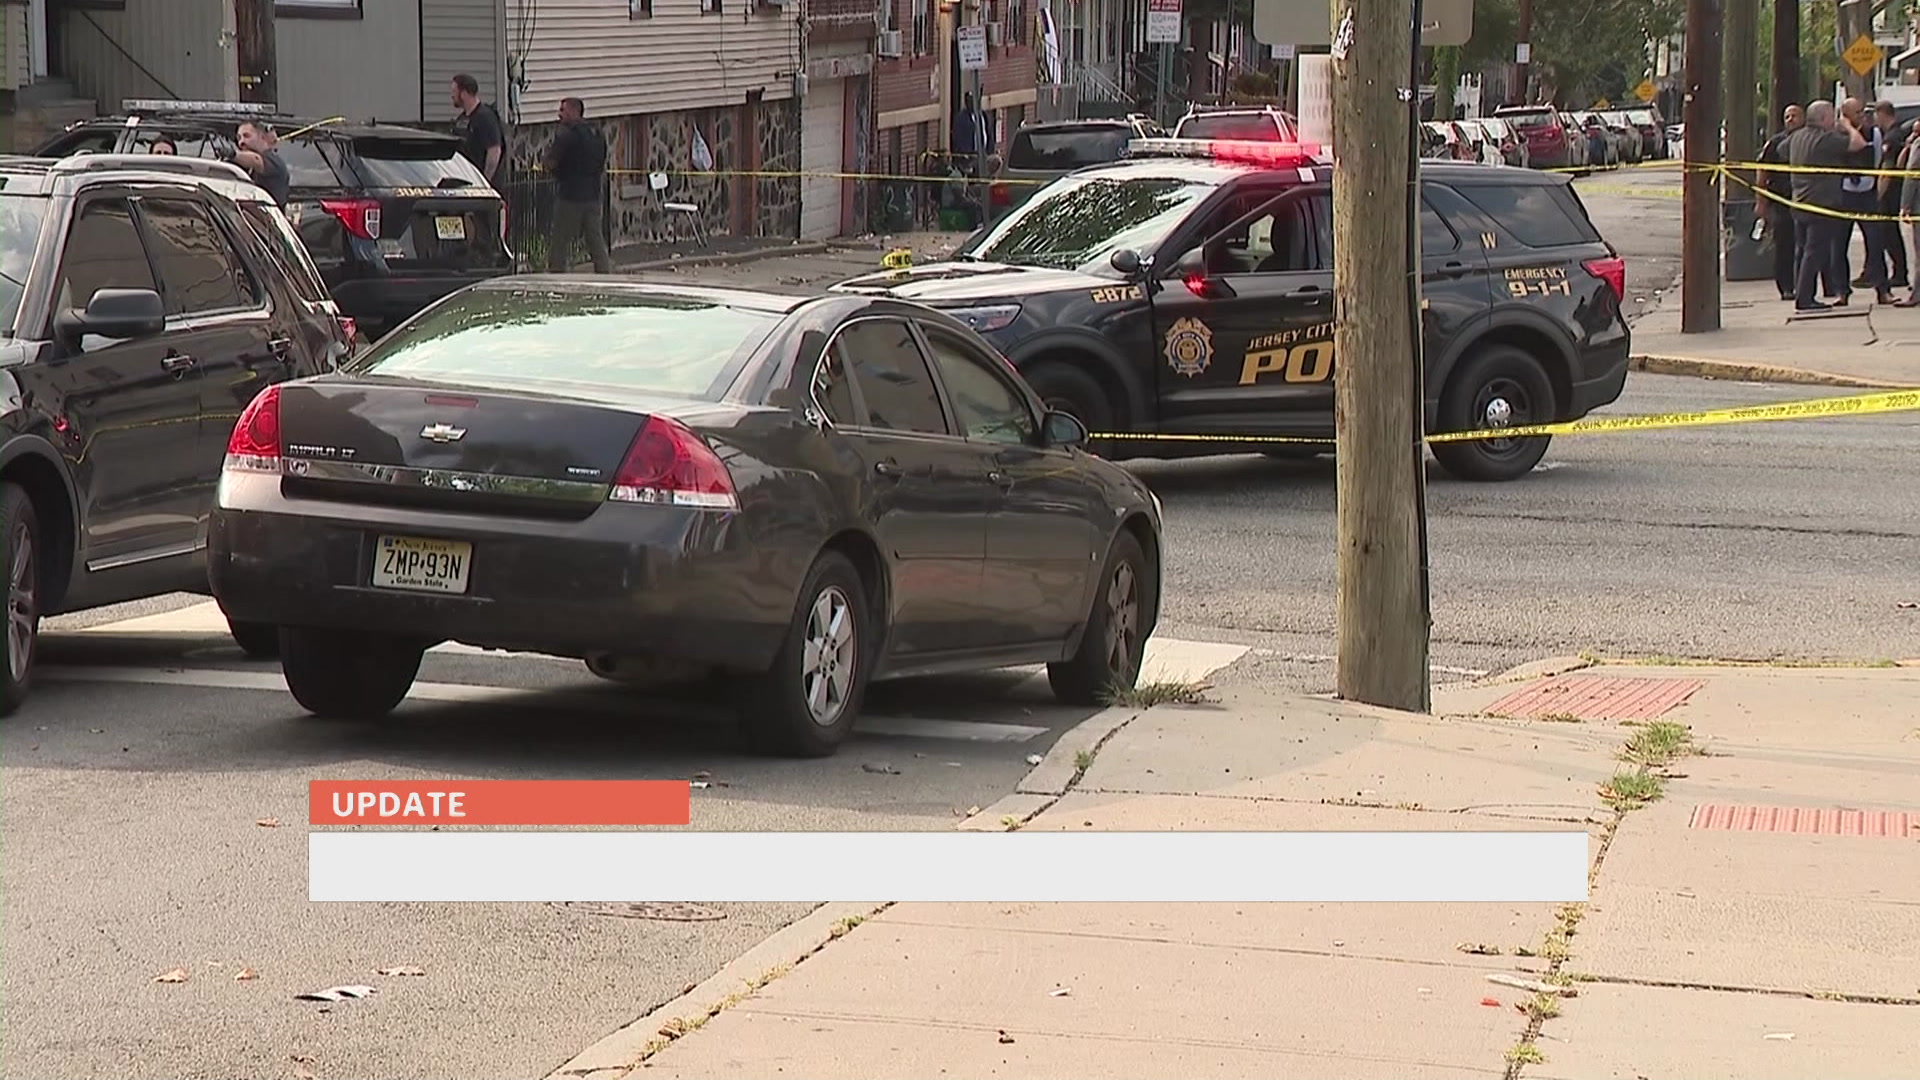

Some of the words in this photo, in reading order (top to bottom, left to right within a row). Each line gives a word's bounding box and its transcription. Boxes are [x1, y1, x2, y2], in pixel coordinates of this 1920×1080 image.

[1480, 231, 1496, 249] W
[1504, 267, 1566, 280] EMERGENCY
[1090, 286, 1143, 303] 2872
[1508, 280, 1571, 298] 9-1-1
[1247, 328, 1301, 350] JERSEY
[1306, 320, 1338, 339] CITY
[1238, 341, 1335, 385] PO
